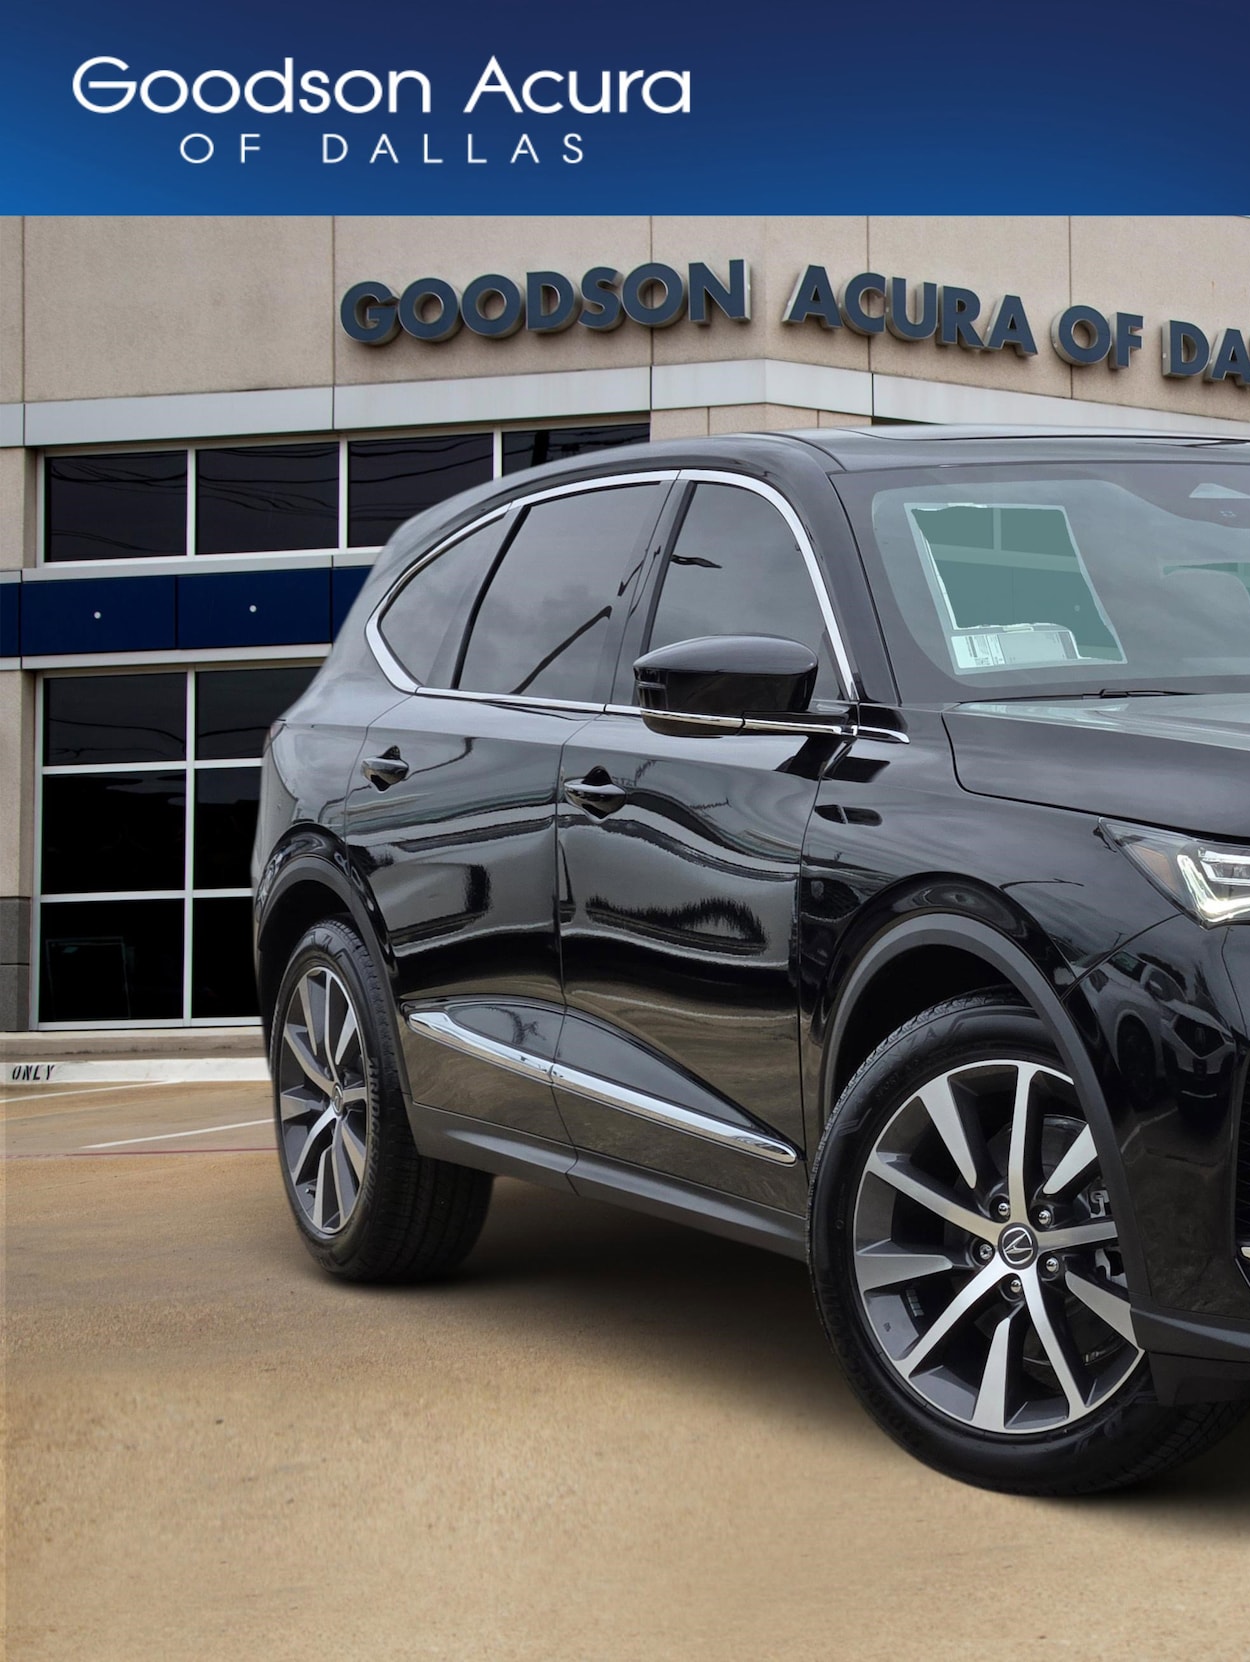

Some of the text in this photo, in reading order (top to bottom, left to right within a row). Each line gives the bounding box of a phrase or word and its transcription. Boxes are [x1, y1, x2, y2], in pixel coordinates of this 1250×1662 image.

[340, 258, 751, 346] GOODSON
[783, 264, 1038, 357] ACURA
[1051, 304, 1144, 370] OF
[12, 1064, 56, 1081] ONLY
